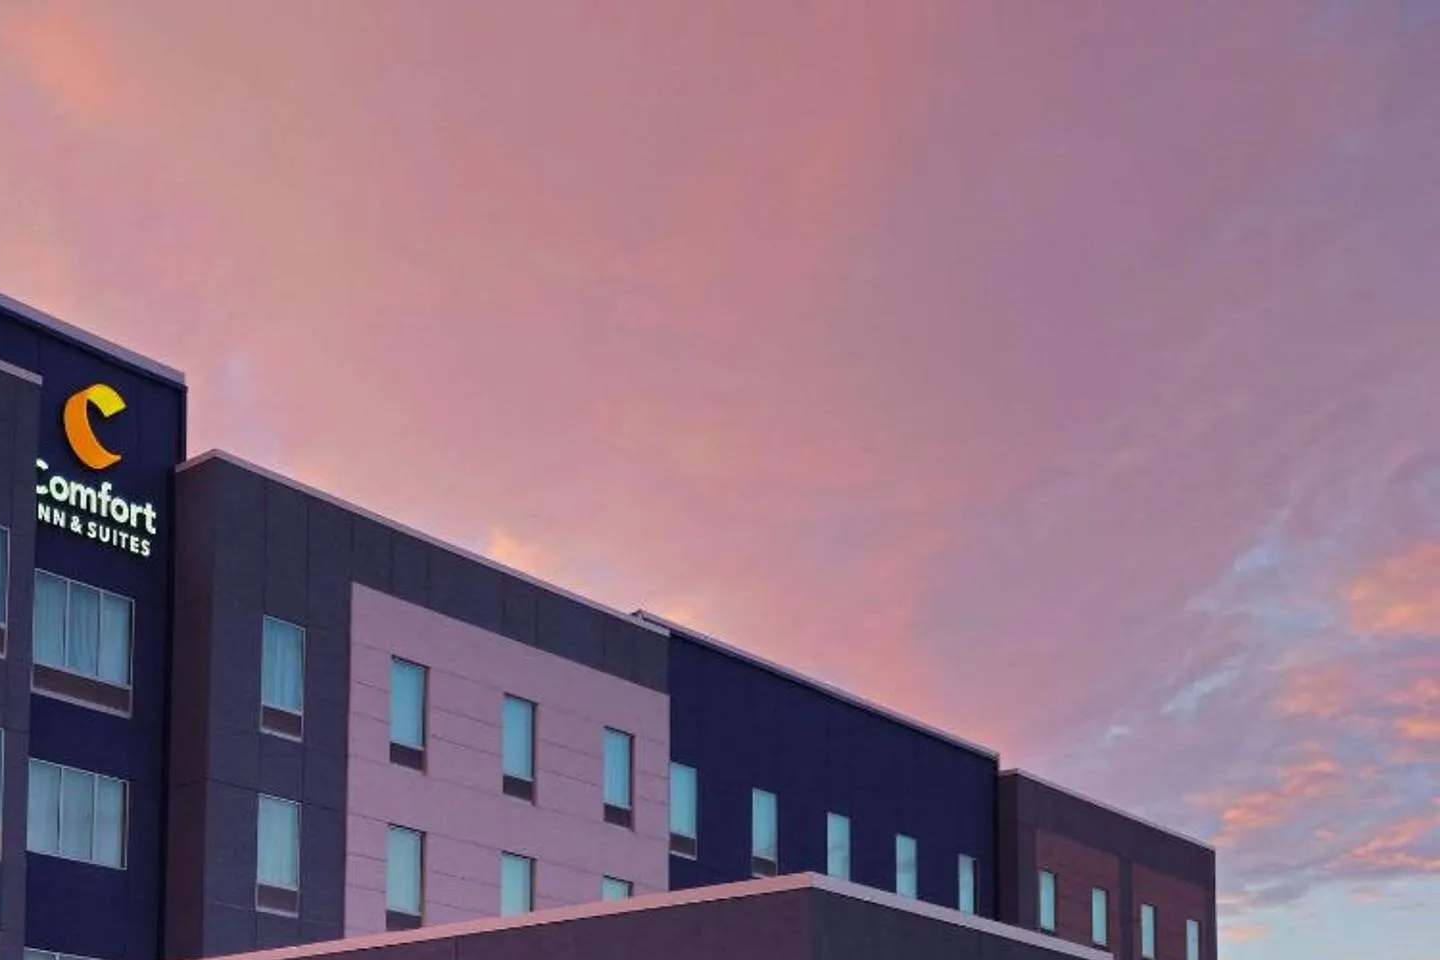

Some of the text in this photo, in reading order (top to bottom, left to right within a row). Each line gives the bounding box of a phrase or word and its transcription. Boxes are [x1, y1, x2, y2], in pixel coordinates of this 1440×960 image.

[37, 503, 151, 557] NN & SUITES
